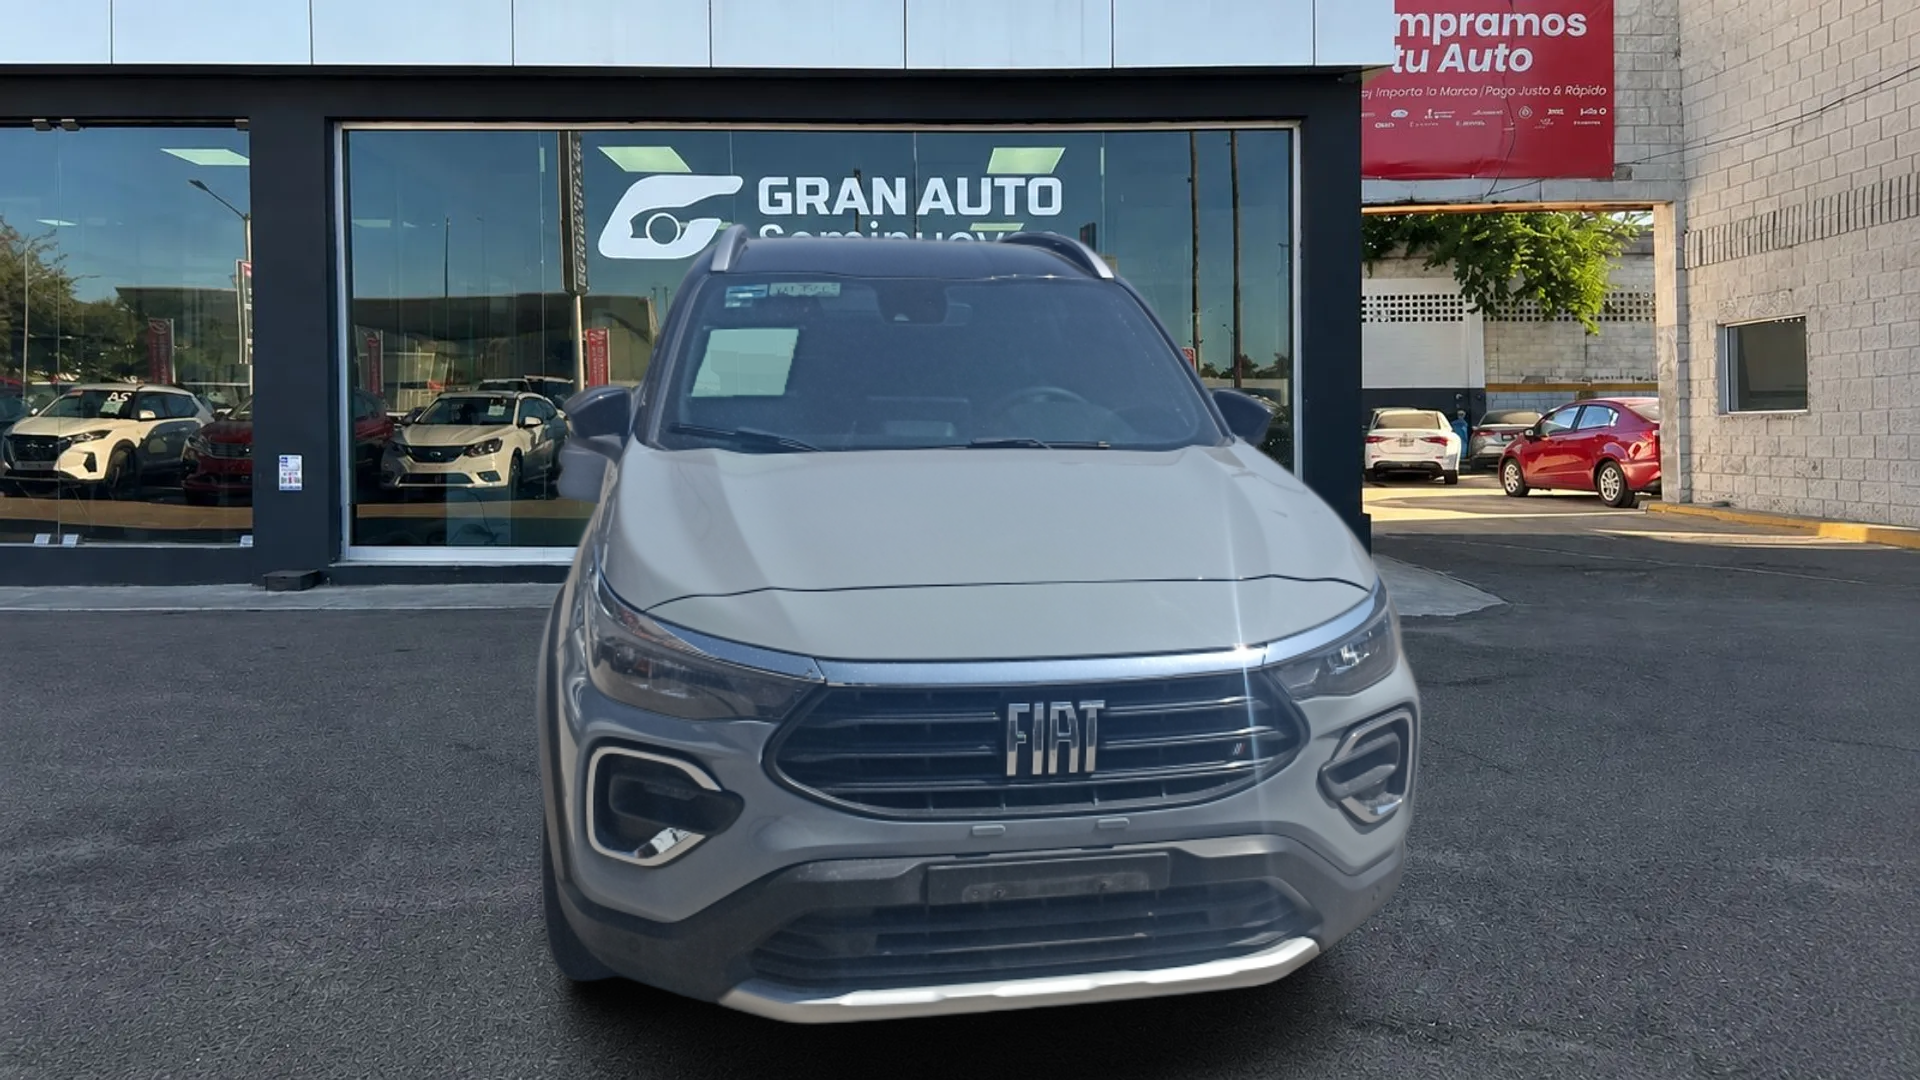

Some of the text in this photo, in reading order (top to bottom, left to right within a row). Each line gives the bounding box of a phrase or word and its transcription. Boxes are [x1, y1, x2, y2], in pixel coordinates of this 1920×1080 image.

[1392, 43, 1533, 73] tu Auto
[1376, 87, 1423, 99] Importa
[1426, 86, 1437, 96] la
[1440, 86, 1478, 97] Marca
[1519, 86, 1551, 96] Justo
[758, 176, 1062, 216] GRAN AUTO
[1006, 700, 1105, 776] FIAT
